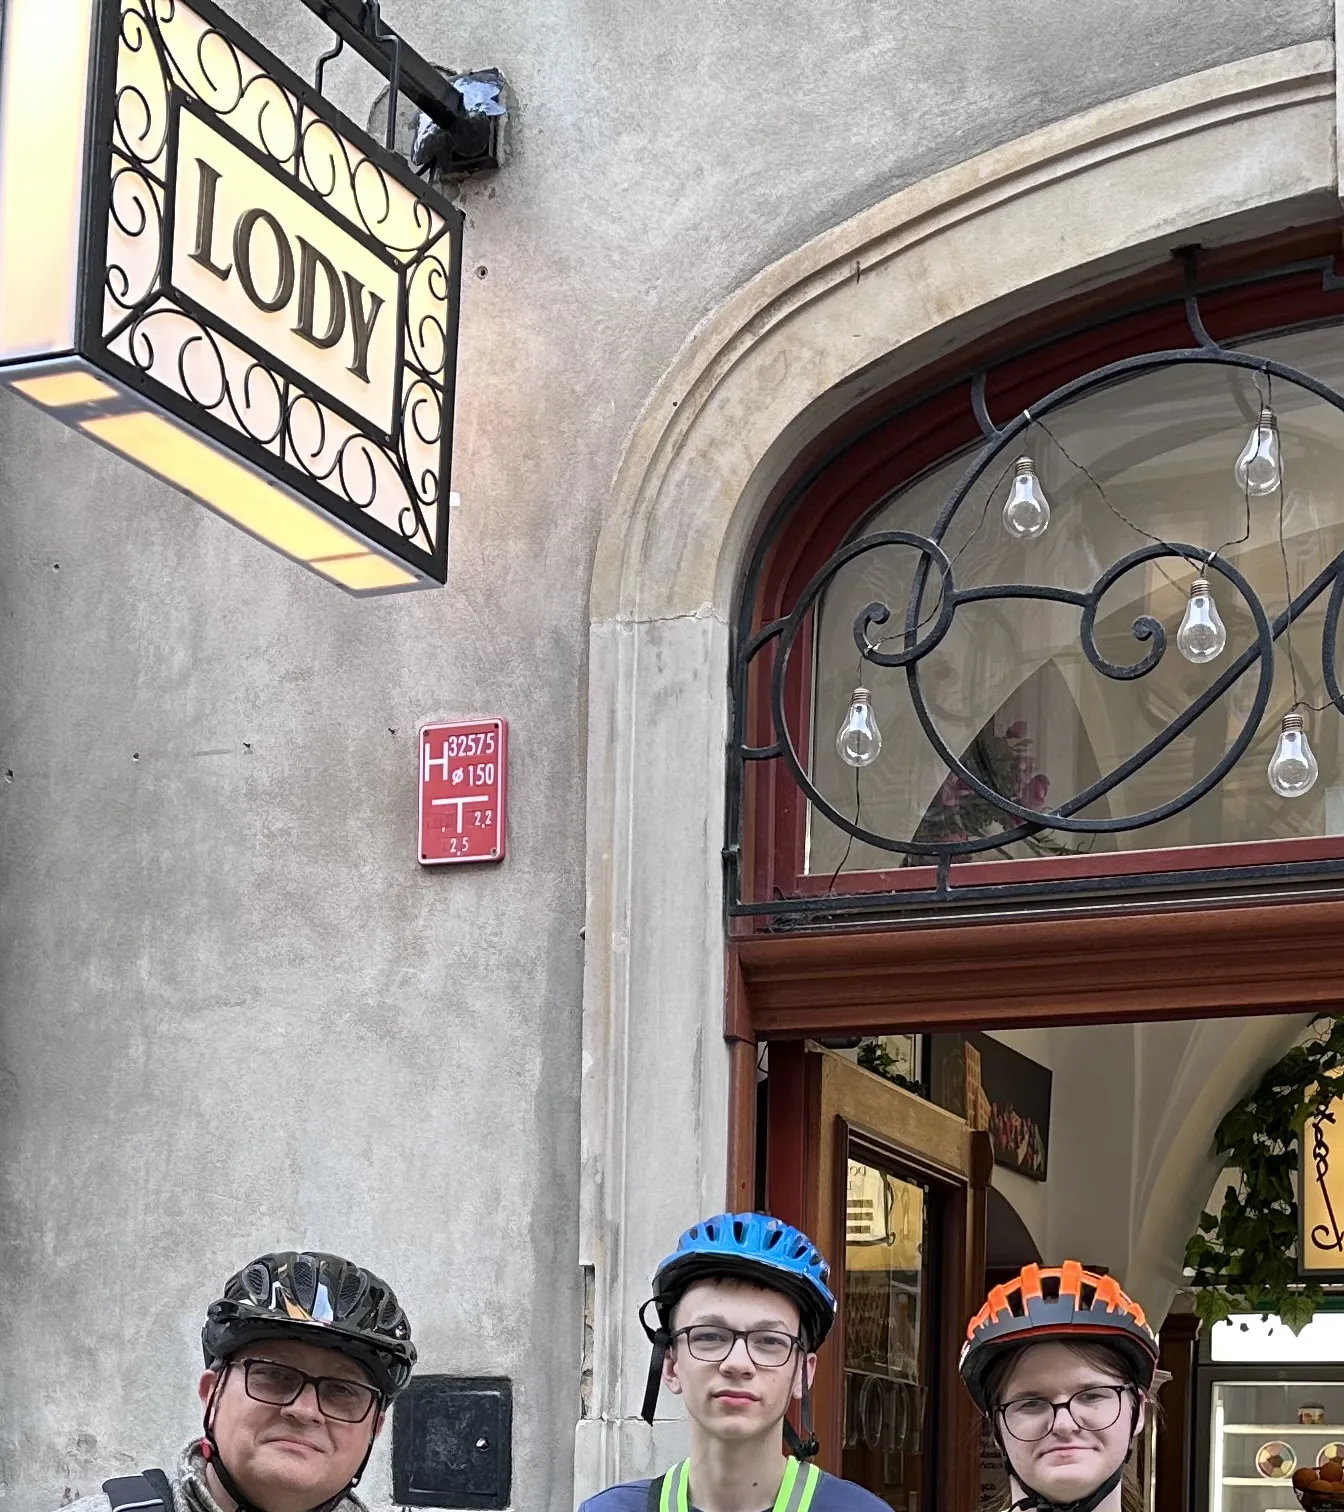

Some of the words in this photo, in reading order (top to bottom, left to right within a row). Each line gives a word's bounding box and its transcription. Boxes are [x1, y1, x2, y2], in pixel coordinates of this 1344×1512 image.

[188, 158, 386, 384] LODY
[448, 733, 495, 757] 32575
[424, 741, 449, 782] H
[468, 763, 495, 787] 150
